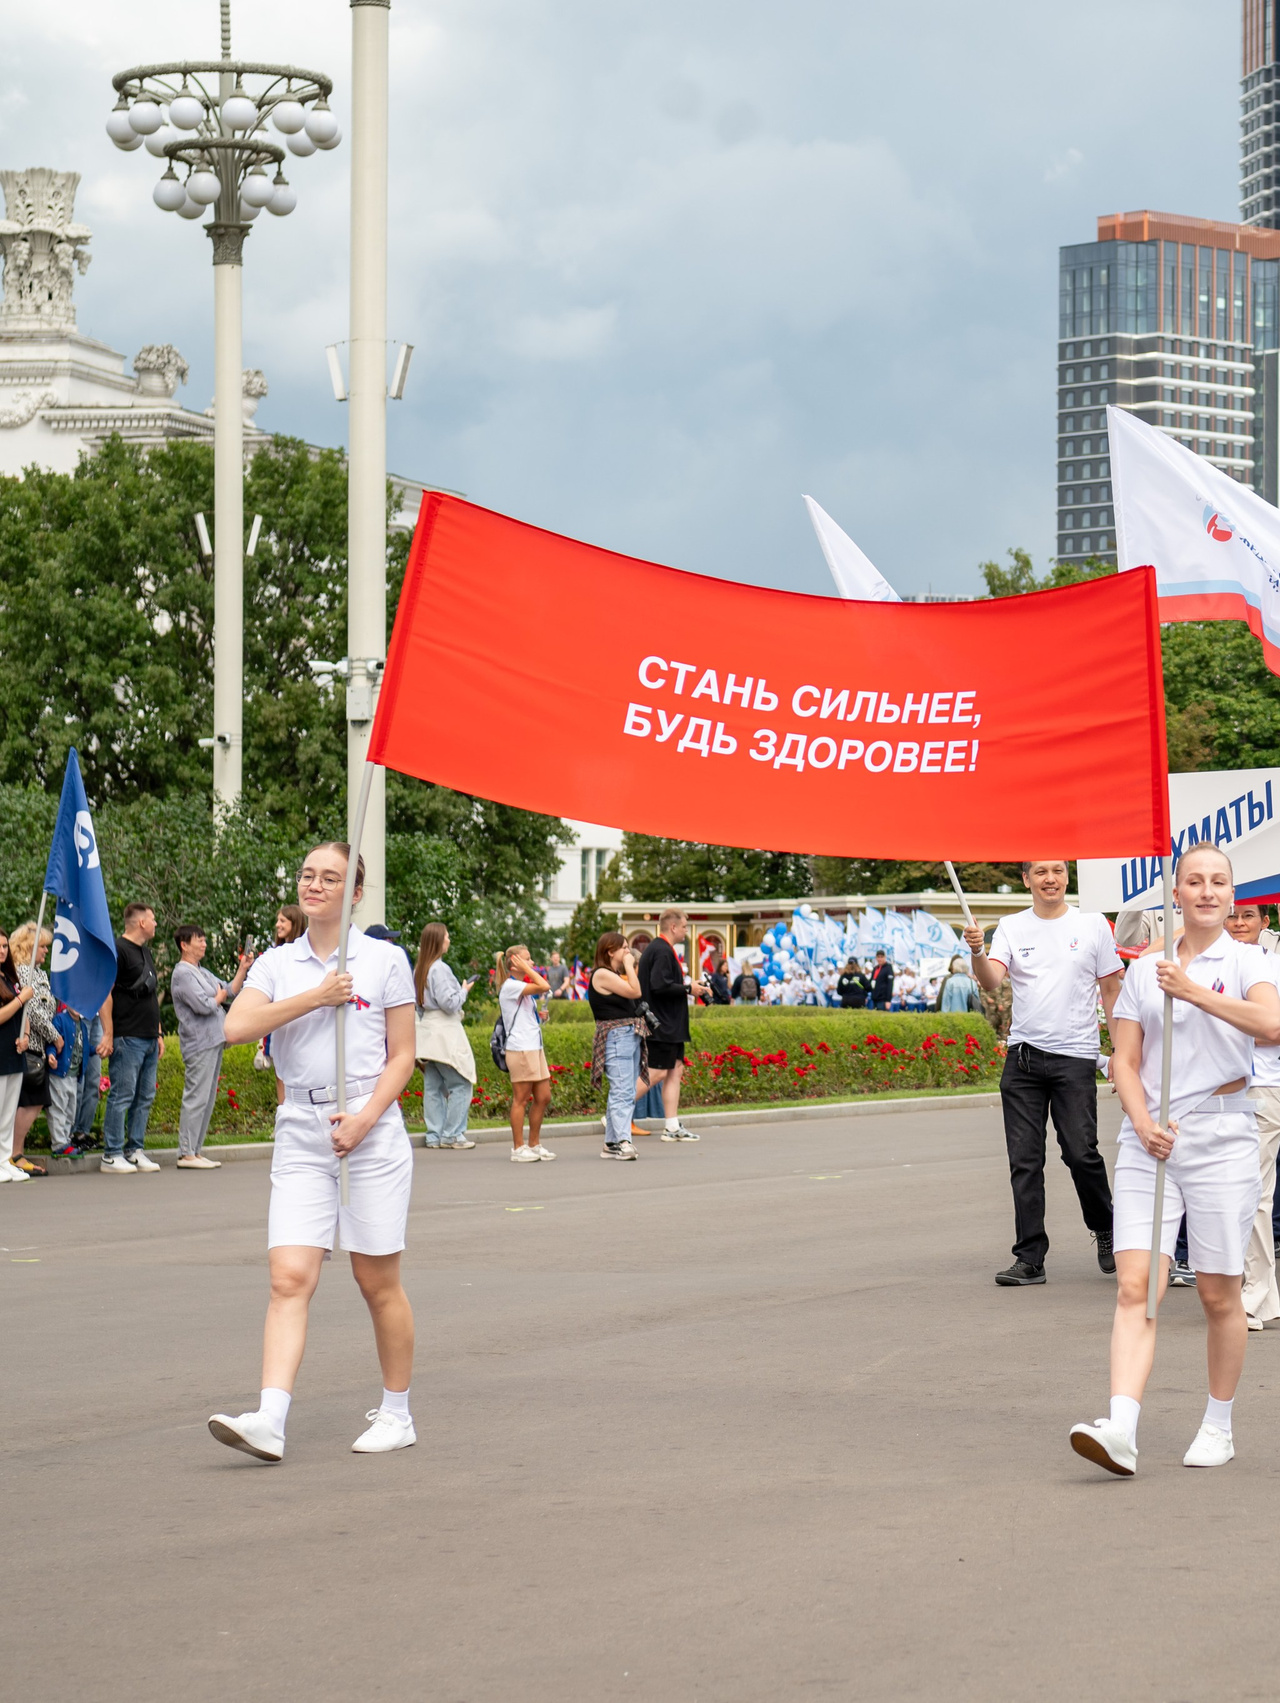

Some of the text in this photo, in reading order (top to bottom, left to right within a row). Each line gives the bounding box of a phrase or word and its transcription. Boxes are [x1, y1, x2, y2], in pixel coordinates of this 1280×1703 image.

[638, 655, 982, 728] СТАНЬ СИЛЬНЕЕ,
[623, 702, 980, 773] БУДЬ ЗДОРОВЕЕ!
